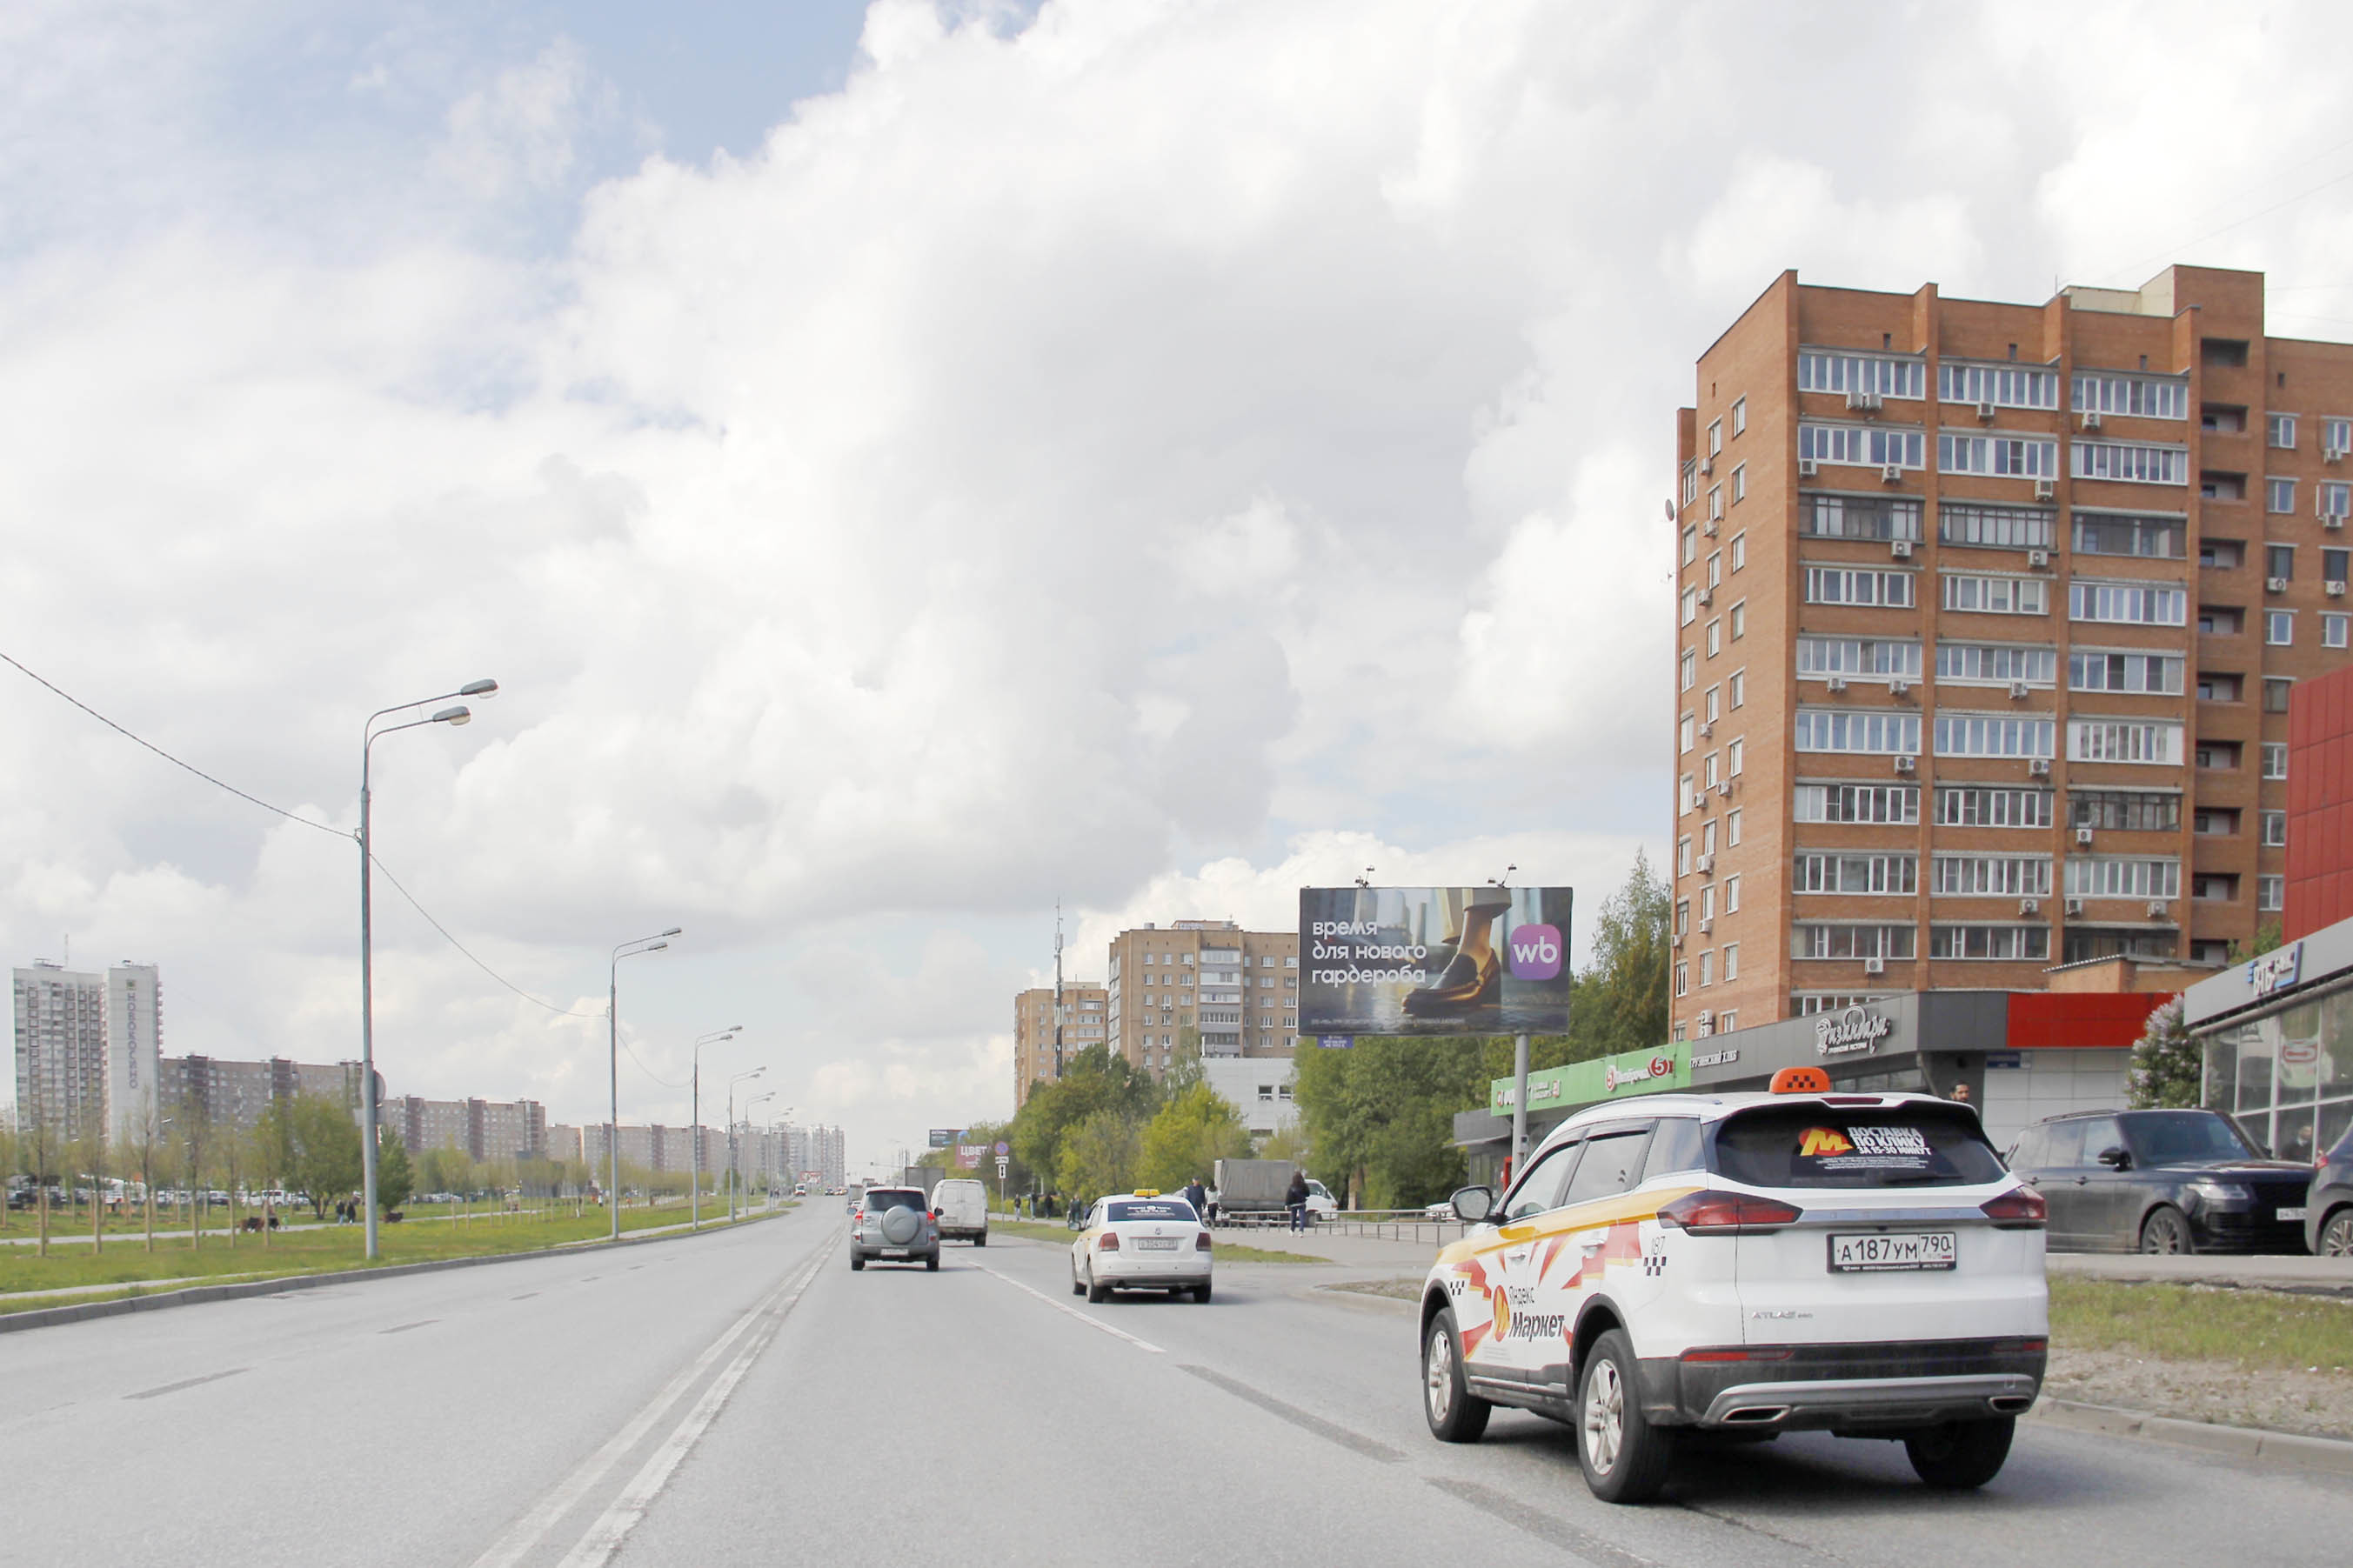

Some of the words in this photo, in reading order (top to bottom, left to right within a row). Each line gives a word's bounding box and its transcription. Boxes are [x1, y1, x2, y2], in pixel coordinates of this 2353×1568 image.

[1313, 920, 1378, 937] время
[1312, 940, 1349, 960] для
[1355, 945, 1427, 960] нового
[1513, 936, 1558, 964] wb
[1312, 964, 1427, 986] гардероба
[1847, 1126, 1922, 1138] ДОСТАВКА
[1851, 1136, 1872, 1147] ПО
[1875, 1136, 1925, 1148] КЛИКУ
[1508, 1311, 1565, 1343] Маркет
